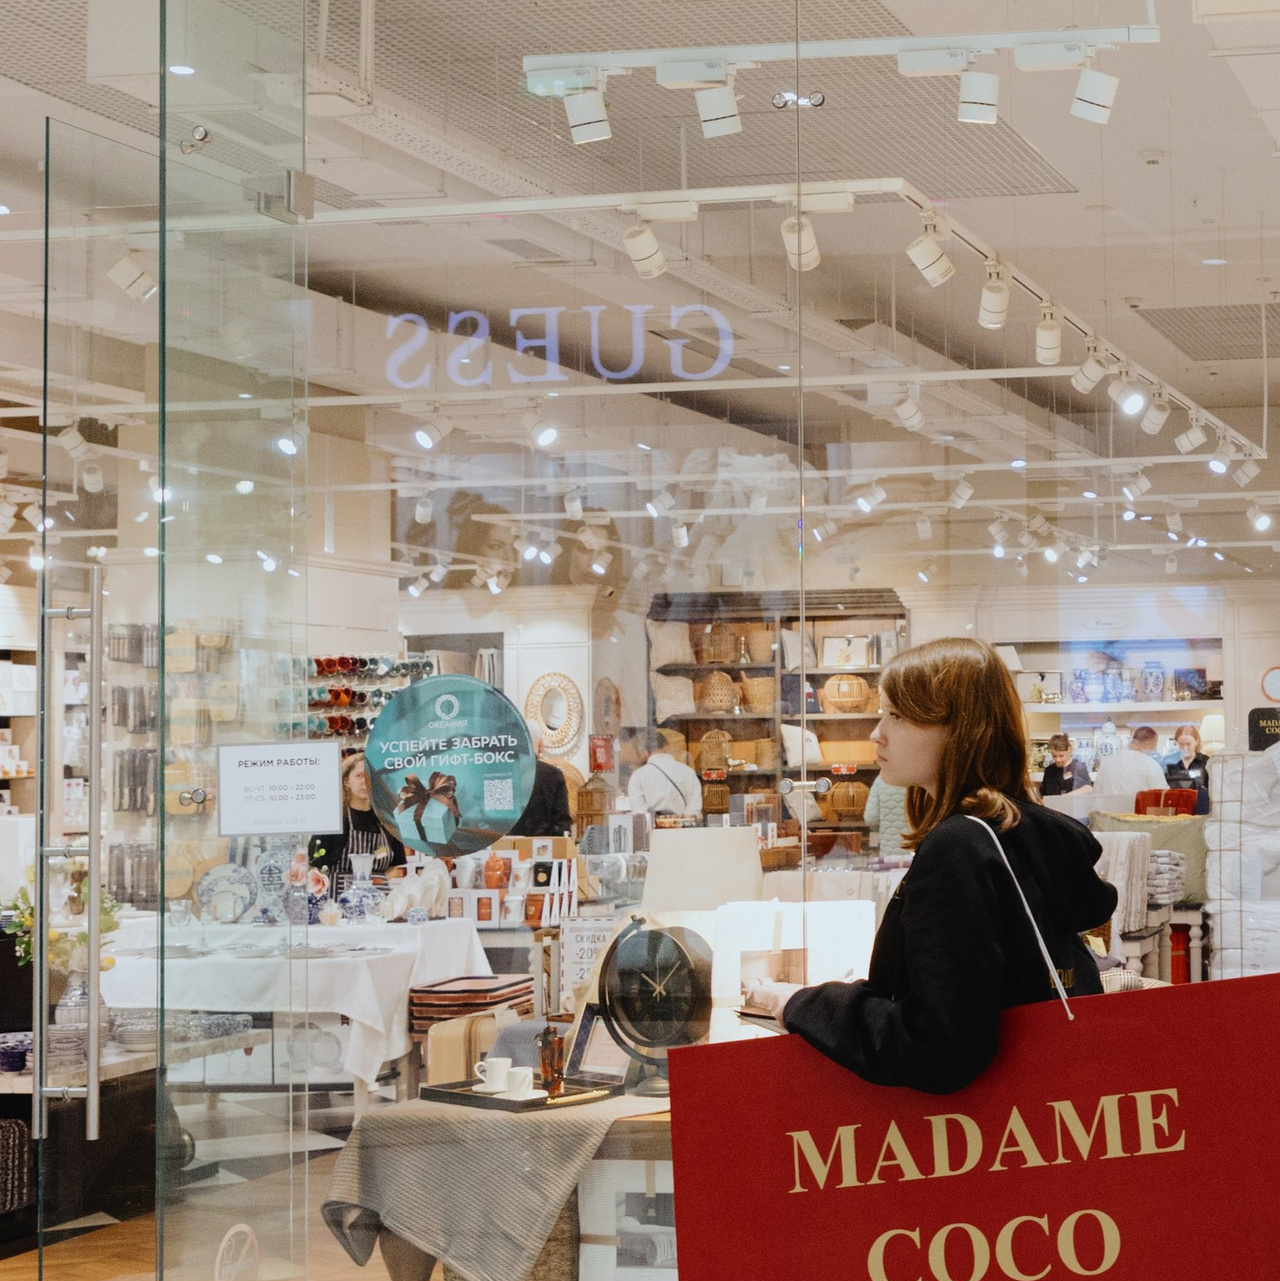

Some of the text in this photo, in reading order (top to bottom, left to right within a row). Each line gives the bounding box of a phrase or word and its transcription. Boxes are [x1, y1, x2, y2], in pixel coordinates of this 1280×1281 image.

[380, 735, 518, 754] УСПЕЙТЕ ЗАБРАТЬ
[238, 758, 320, 768] РЕЖИМ РАБОТЫ:
[384, 750, 515, 770] СВОЙ ГИФТ-БОКС
[575, 934, 607, 943] СКИДКА
[786, 1088, 1186, 1194] MADAME
